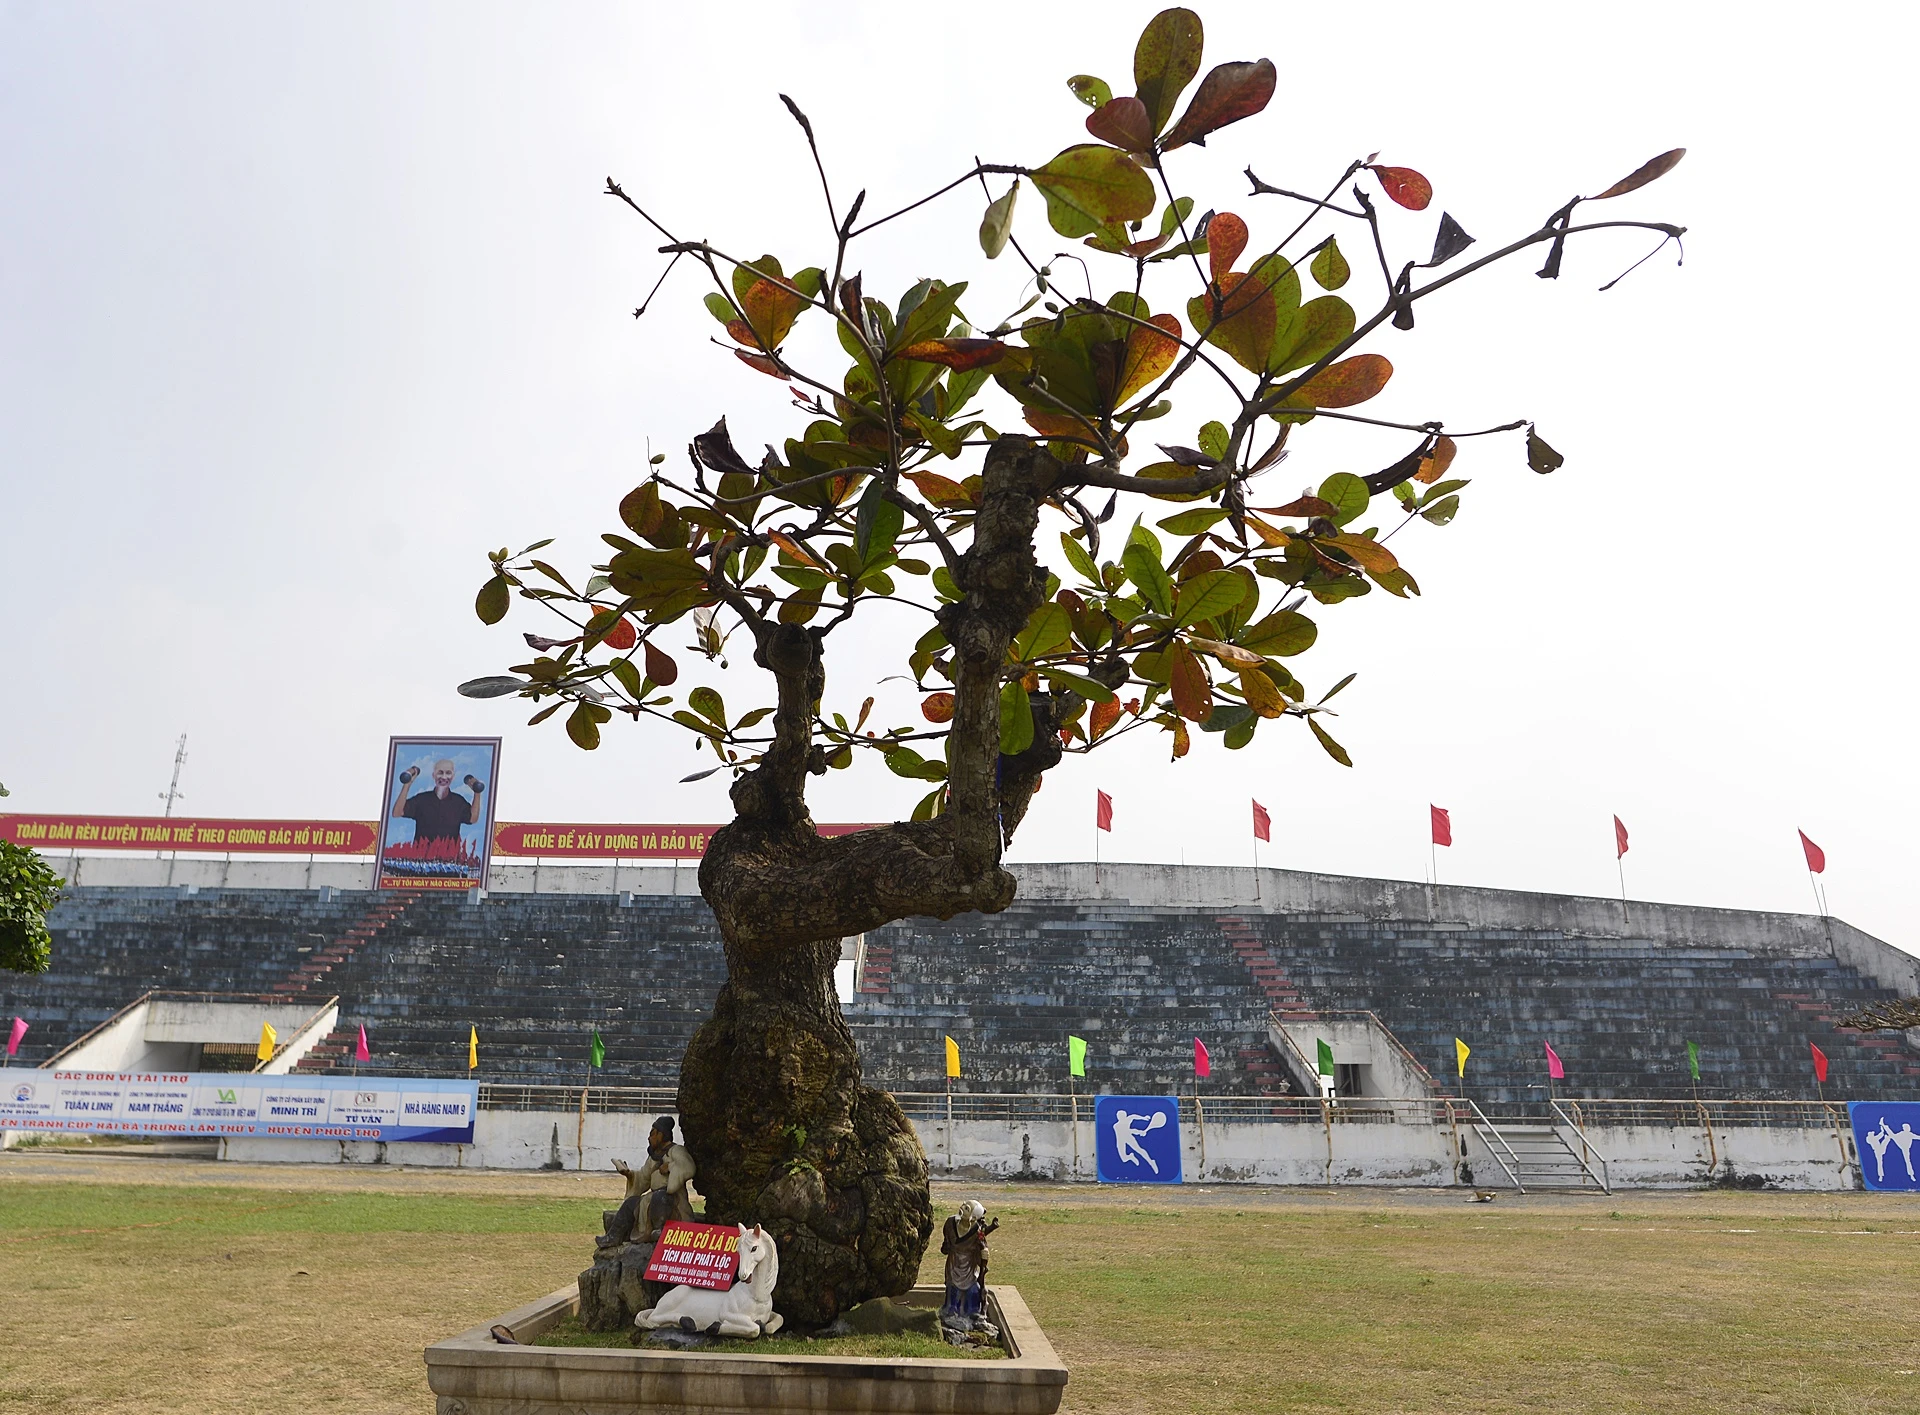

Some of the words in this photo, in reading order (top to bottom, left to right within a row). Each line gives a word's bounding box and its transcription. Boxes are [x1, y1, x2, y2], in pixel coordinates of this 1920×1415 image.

[17, 822, 47, 839] TOÀN
[49, 822, 73, 840] DÂN
[76, 823, 99, 841] RÈN
[102, 824, 138, 844] LUYỆN
[141, 825, 170, 842] THÂN
[174, 823, 197, 843] THỂ
[198, 828, 225, 844] THEO
[228, 828, 266, 845] GƯƠNG
[268, 829, 292, 845] BÁC
[294, 826, 311, 845] HỒ
[325, 831, 345, 848] ĐẠI
[522, 829, 555, 848] KHỎE
[558, 829, 576, 848] ĐỂ
[577, 832, 601, 849] XÂY
[604, 834, 638, 852] DỰNG
[642, 834, 657, 849] VÀ
[661, 830, 685, 850] BẢO
[689, 832, 705, 852] VỆ
[54, 1072, 82, 1080] CÁC
[119, 1073, 131, 1083] VỊ
[137, 1074, 157, 1082] TÀI
[91, 1102, 113, 1110] LINH
[128, 1103, 150, 1112] NAM
[271, 1107, 299, 1115] MINH
[404, 1101, 419, 1114] NHÀ
[421, 1102, 440, 1114] HÀNG
[442, 1104, 459, 1115] NAM
[22, 1120, 63, 1128] TRANH
[96, 1122, 118, 1130] HAI
[693, 1227, 713, 1249] CỔ
[709, 1231, 726, 1251] LÁ
[661, 1247, 681, 1261] TÍCH
[679, 1250, 695, 1265] KHÍ
[694, 1252, 716, 1268] PHÁT
[714, 1253, 732, 1270] LỘC
